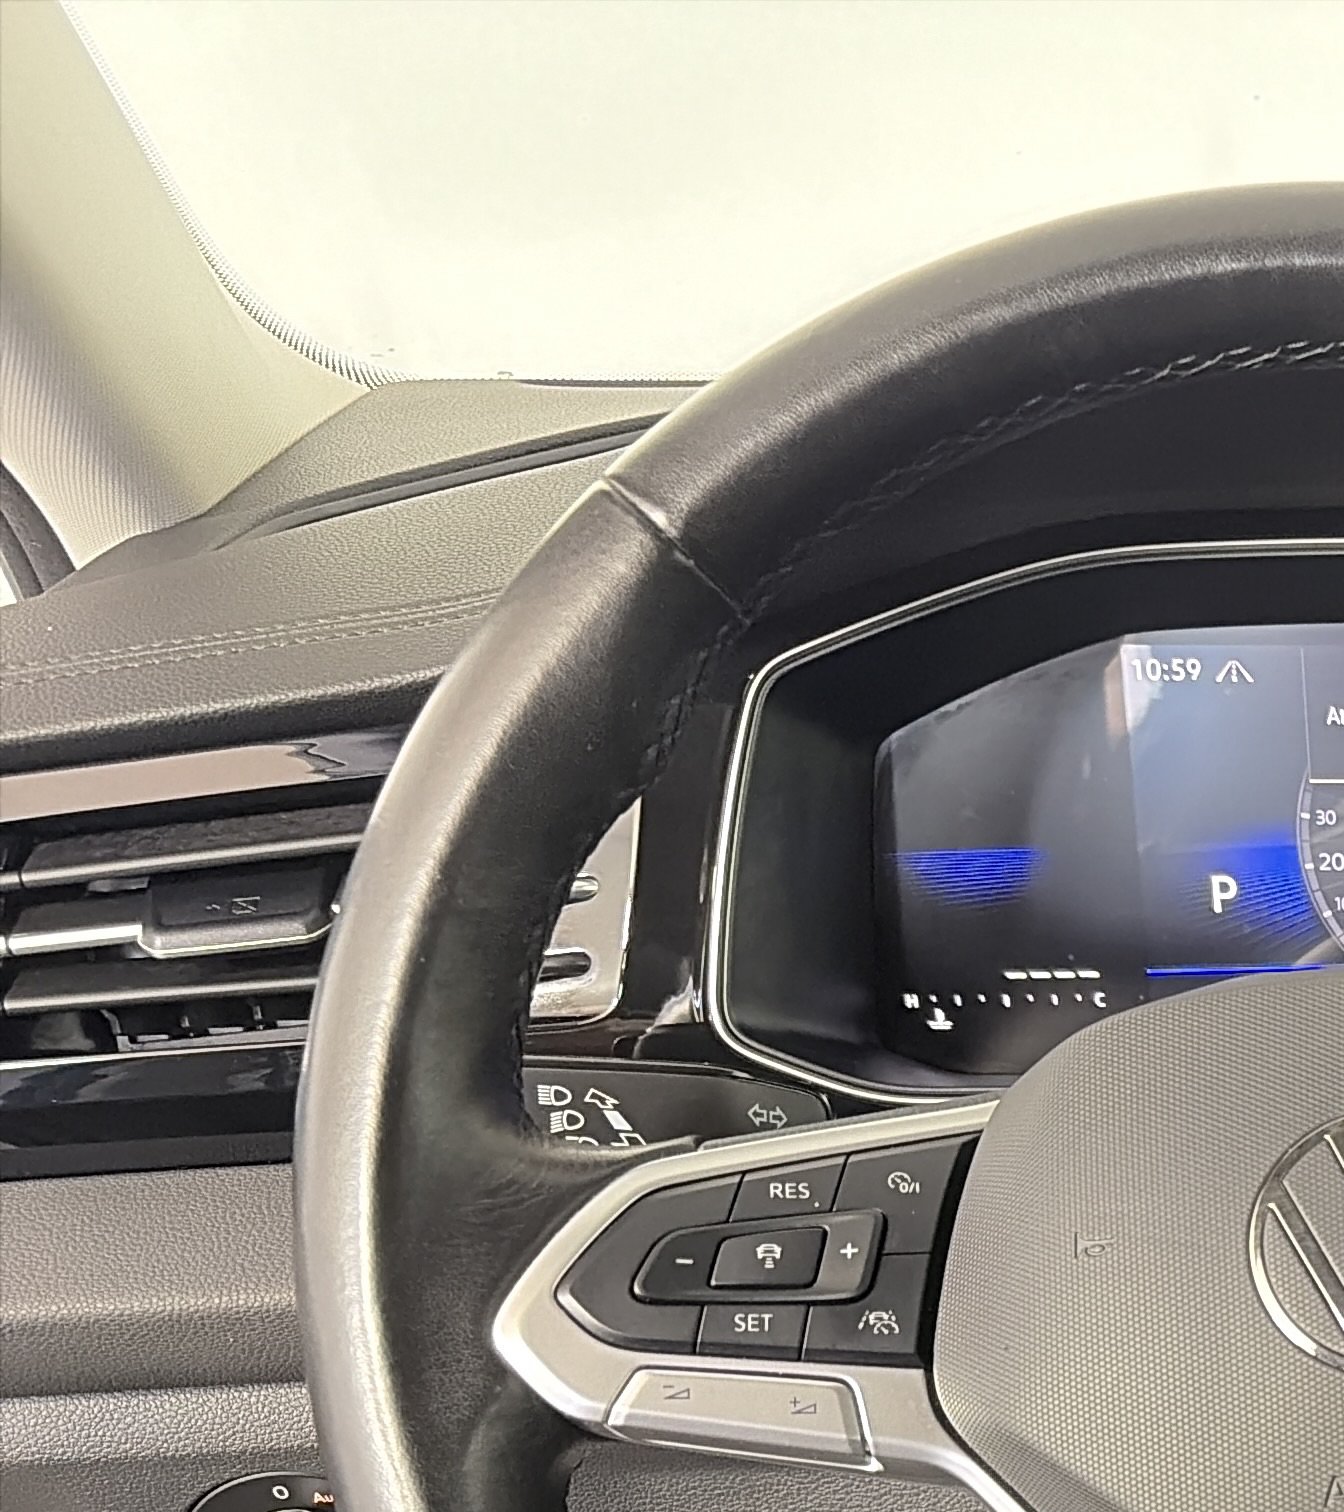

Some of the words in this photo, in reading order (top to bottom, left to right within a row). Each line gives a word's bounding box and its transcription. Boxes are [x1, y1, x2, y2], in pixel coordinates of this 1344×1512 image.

[1131, 658, 1202, 682] 10:59
[1315, 810, 1337, 826] 30
[1211, 875, 1238, 913] P
[769, 1182, 810, 1199] RES
[733, 1313, 773, 1332] SET
